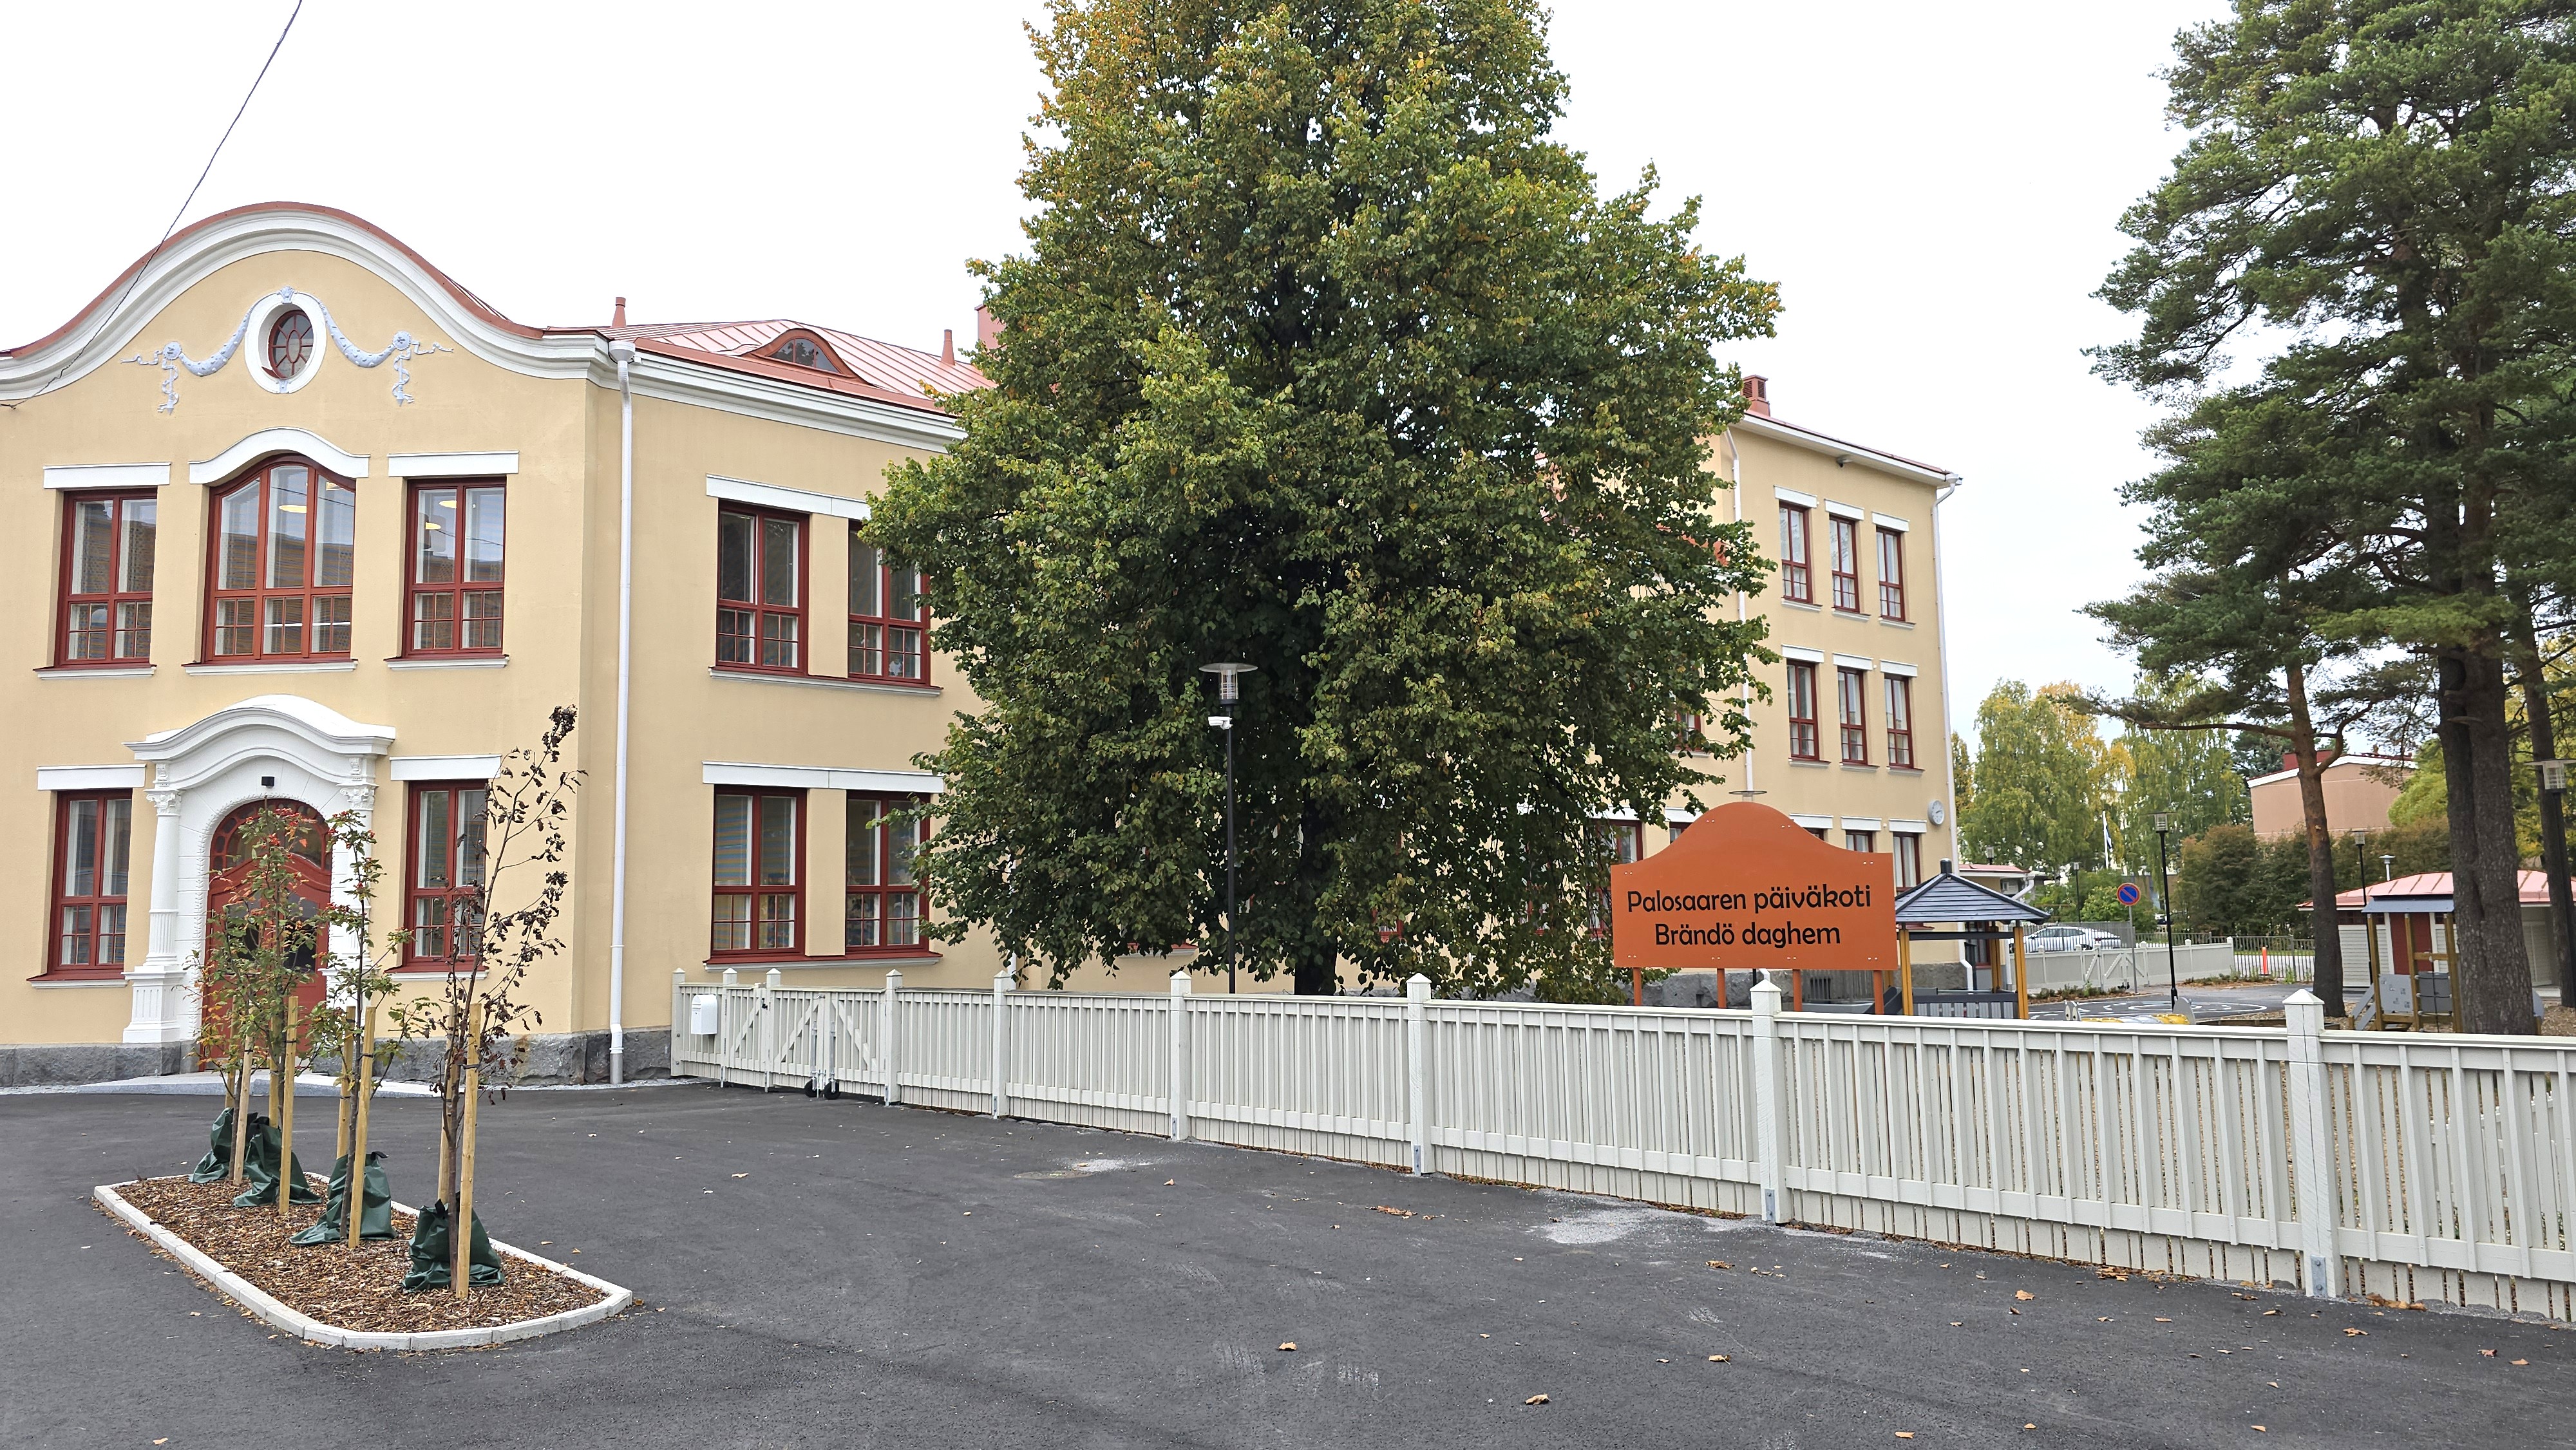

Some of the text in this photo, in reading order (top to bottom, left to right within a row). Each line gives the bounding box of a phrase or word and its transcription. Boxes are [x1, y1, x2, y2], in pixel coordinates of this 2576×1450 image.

[1627, 883, 1871, 914] Palosaaren päiväkoti
[1654, 921, 1841, 949] Brändö daghem
